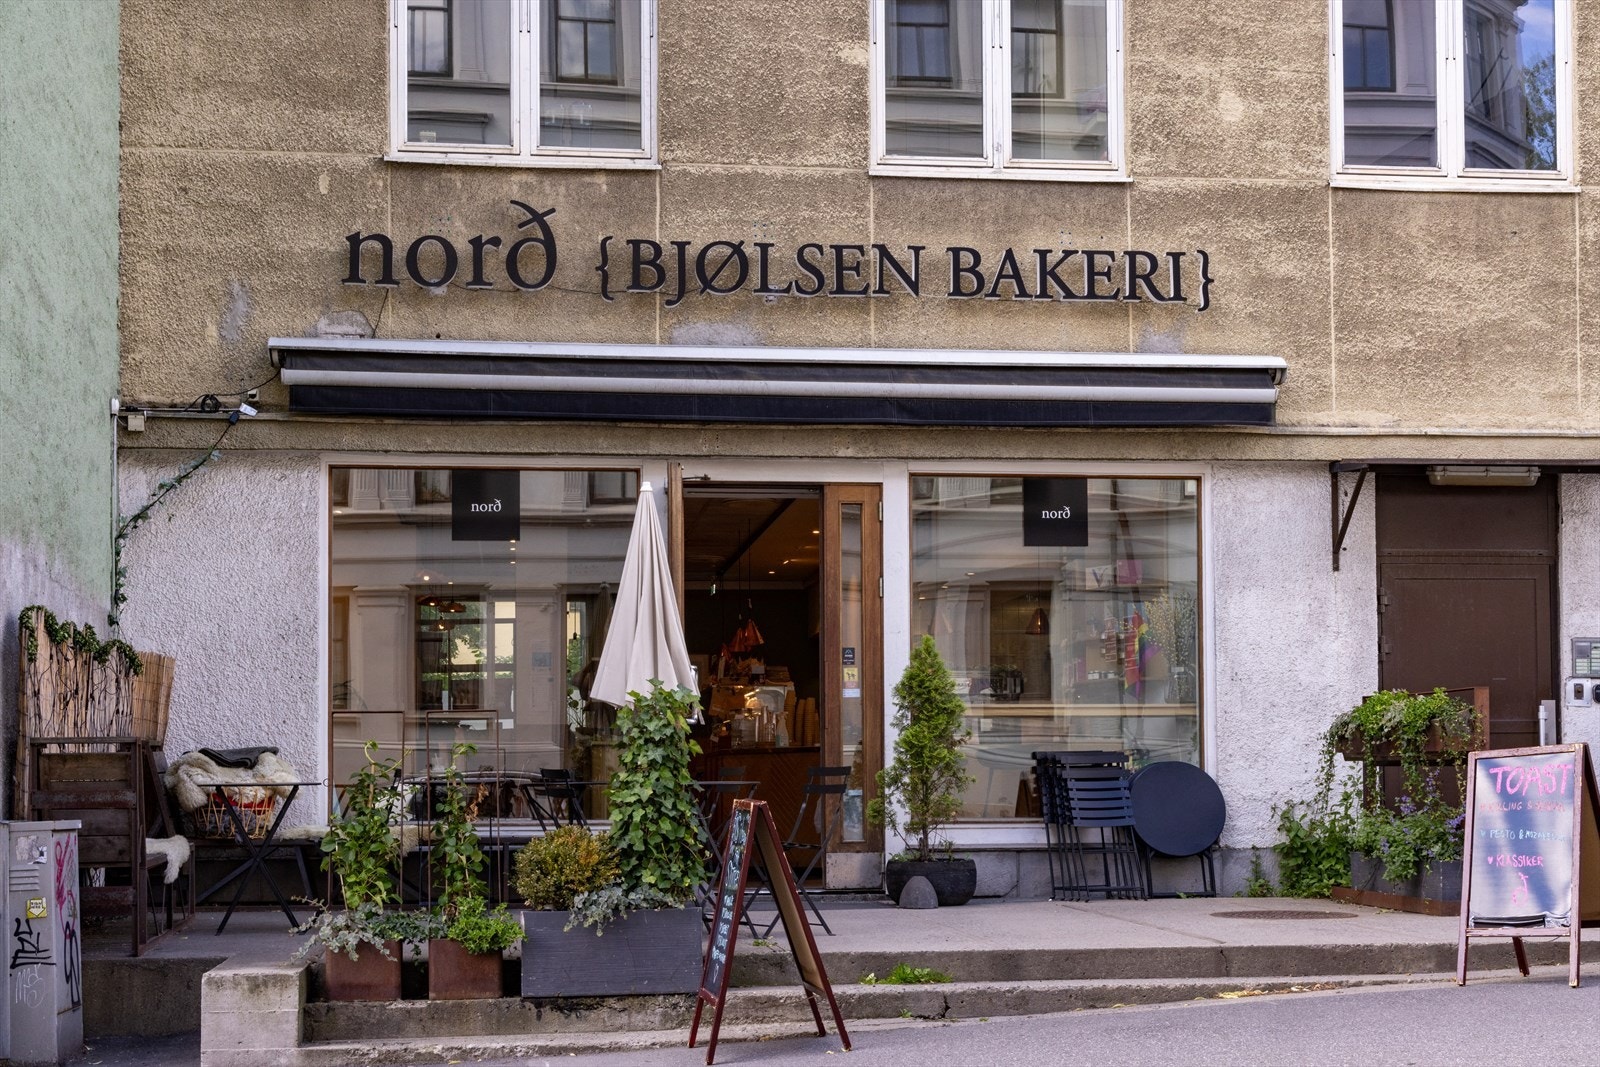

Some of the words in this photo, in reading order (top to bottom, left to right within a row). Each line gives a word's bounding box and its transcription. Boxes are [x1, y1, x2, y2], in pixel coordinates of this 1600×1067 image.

[470, 498, 502, 513] norð
[1041, 505, 1071, 519] norð
[1489, 764, 1573, 796] TOAST
[1496, 854, 1544, 868] KLASSIKER
